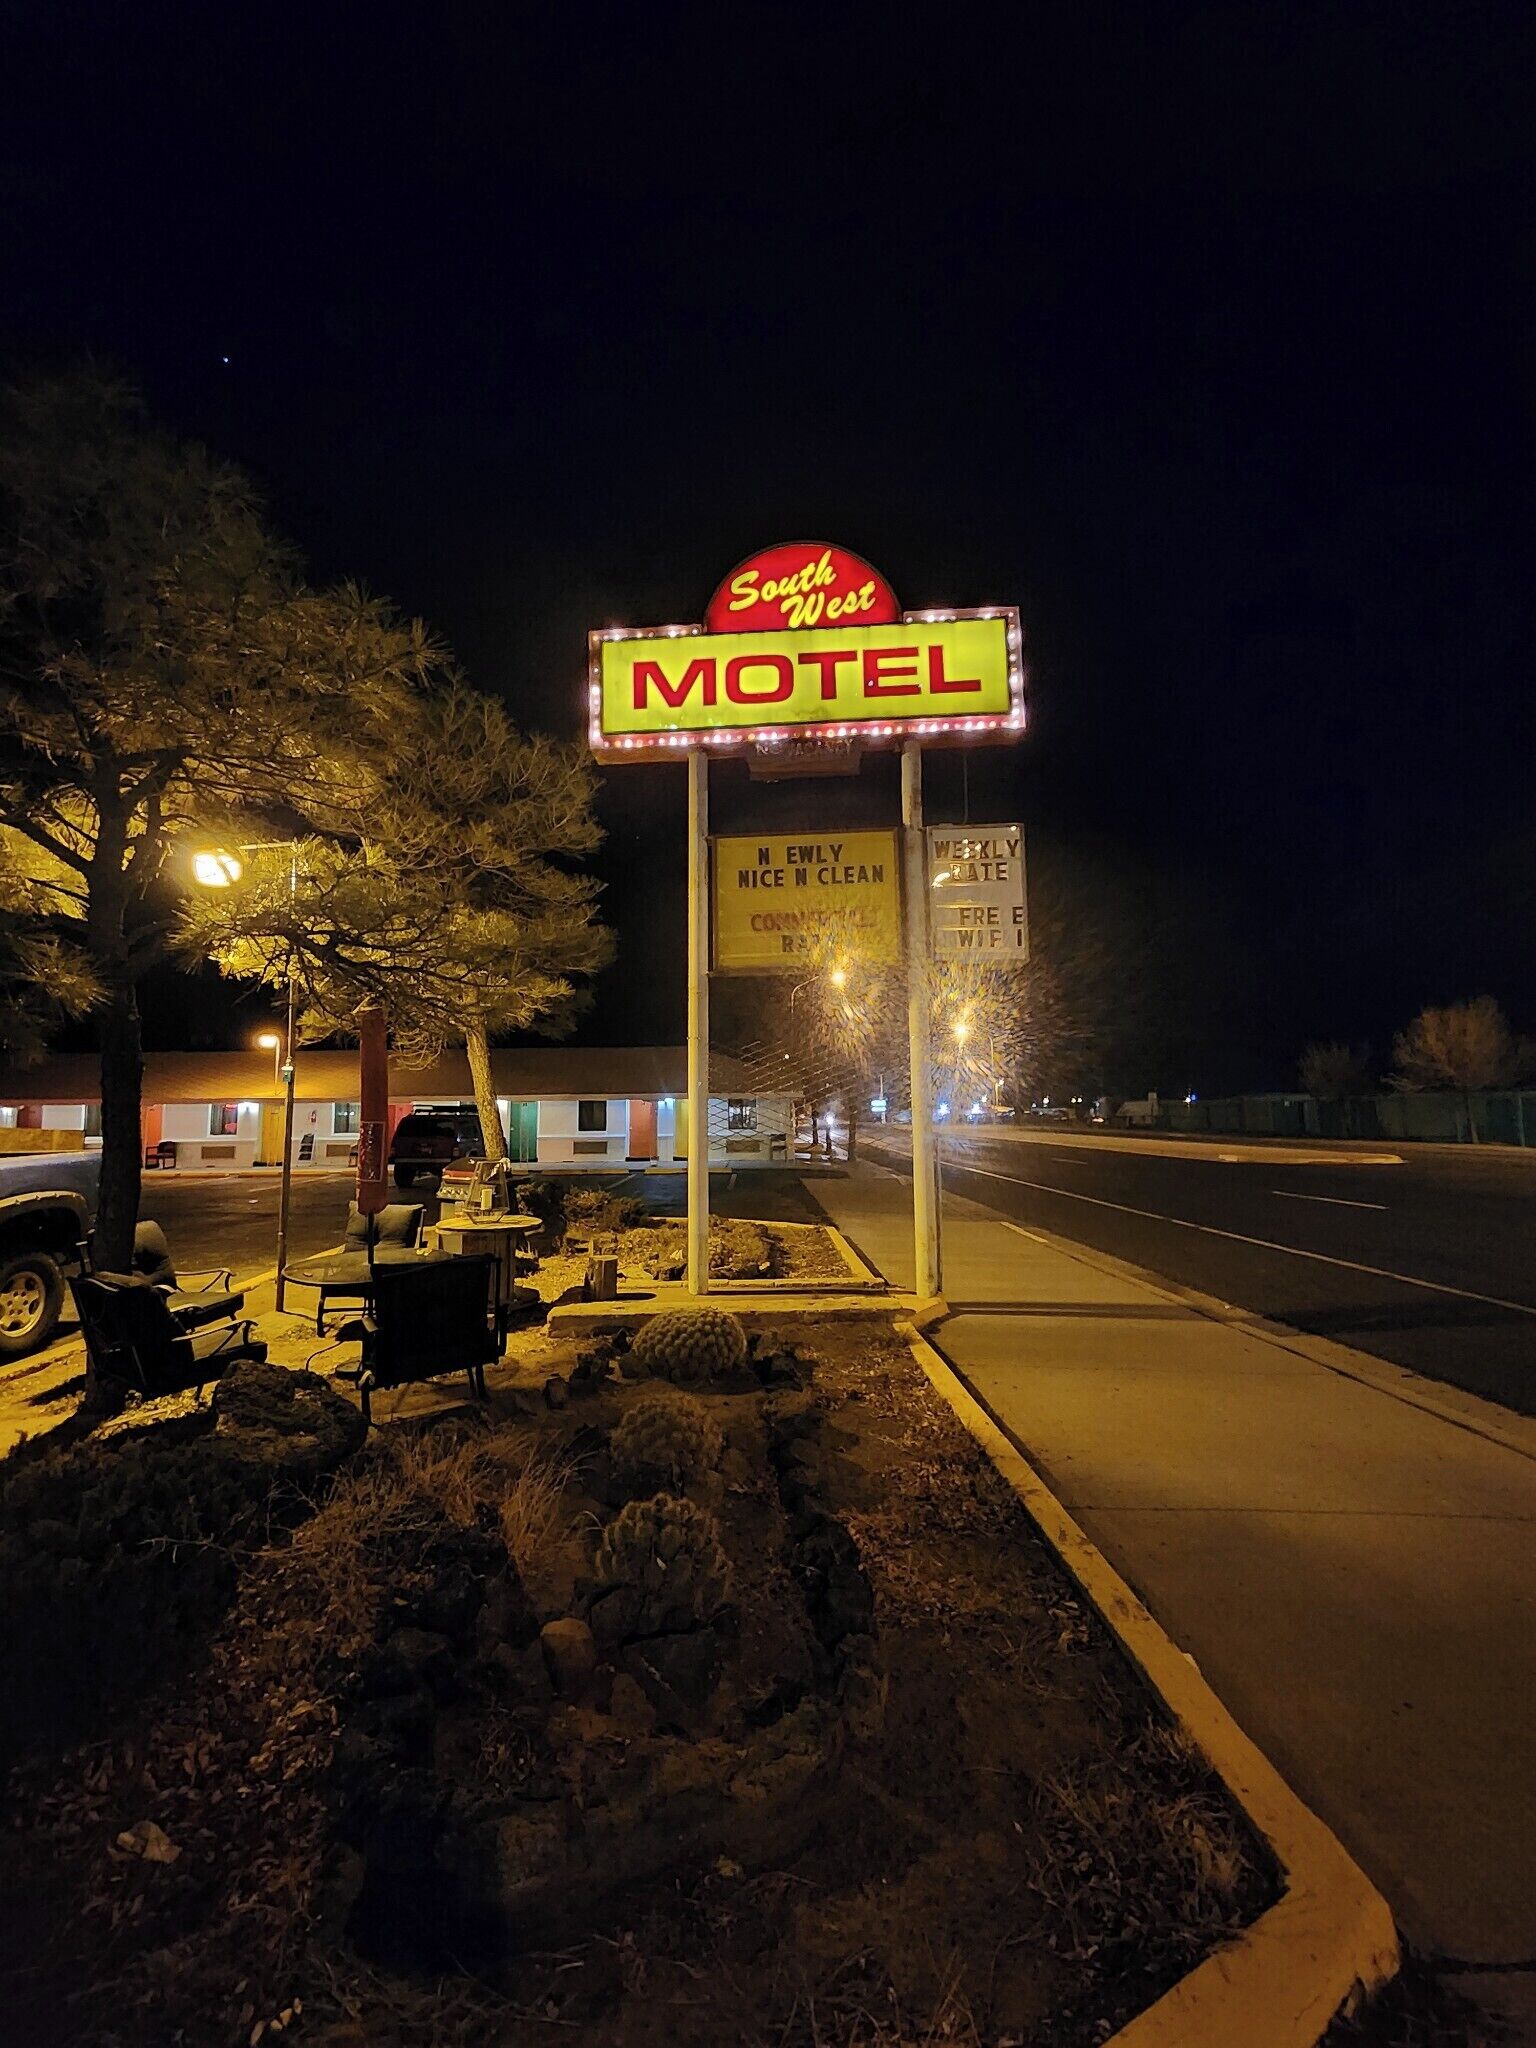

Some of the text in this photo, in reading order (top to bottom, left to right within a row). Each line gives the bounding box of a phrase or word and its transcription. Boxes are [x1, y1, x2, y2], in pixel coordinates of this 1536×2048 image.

[729, 549, 837, 611] South
[780, 580, 876, 629] West
[633, 645, 982, 710] MOTEL
[934, 839, 1020, 859] WEEKLY
[738, 864, 884, 889] NICE N CLEAN
[951, 861, 1008, 881] RATE
